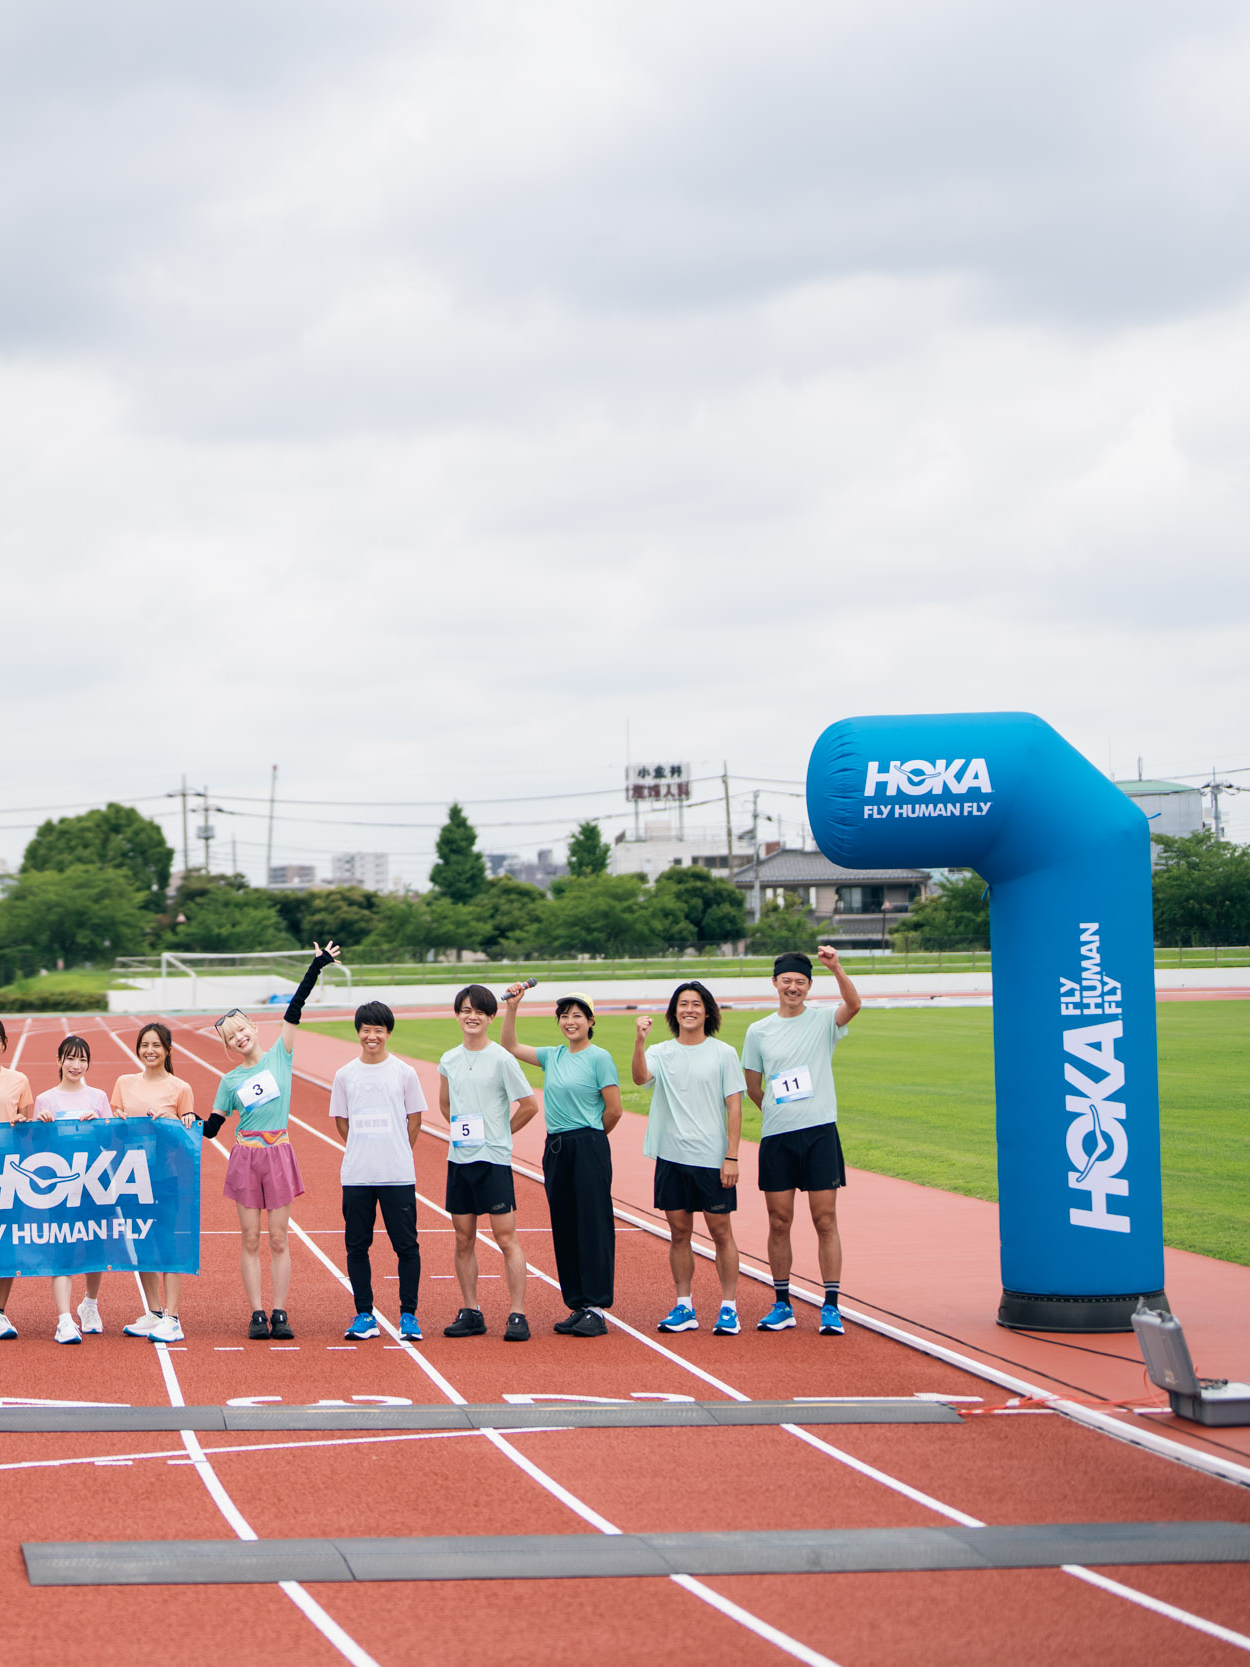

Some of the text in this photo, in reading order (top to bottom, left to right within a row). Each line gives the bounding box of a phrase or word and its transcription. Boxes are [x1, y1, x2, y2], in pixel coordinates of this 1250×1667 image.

[637, 764, 682, 779] 小金井
[864, 758, 992, 797] HOKA
[863, 802, 992, 819] FLY HUMAN FLY
[1079, 922, 1103, 1015] HUMAN
[1059, 976, 1081, 1015] FLY
[1102, 975, 1122, 1014] FLY
[252, 1084, 264, 1096] 3
[782, 1077, 800, 1092] 11
[462, 1123, 470, 1136] 5
[1062, 1019, 1131, 1233] HOKA
[12, 1219, 107, 1245] HUMAN
[112, 1218, 154, 1240] FLY
